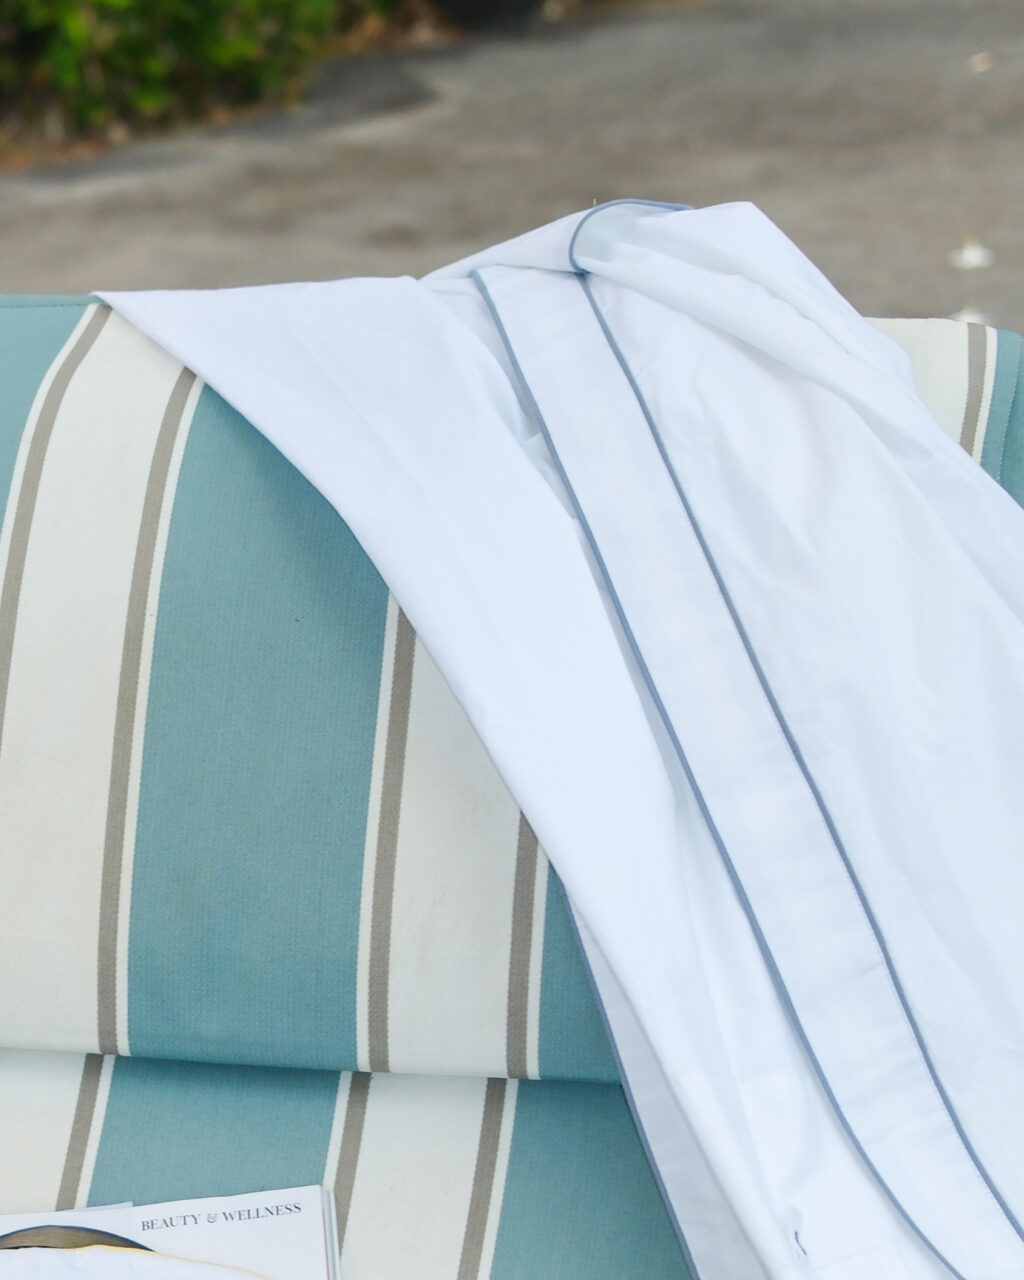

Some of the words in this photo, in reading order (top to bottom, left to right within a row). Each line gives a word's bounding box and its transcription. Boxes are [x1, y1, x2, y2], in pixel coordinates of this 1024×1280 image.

[141, 1213, 201, 1231] BEAUTY
[206, 1213, 218, 1224] &
[222, 1202, 302, 1222] WELLNESS
